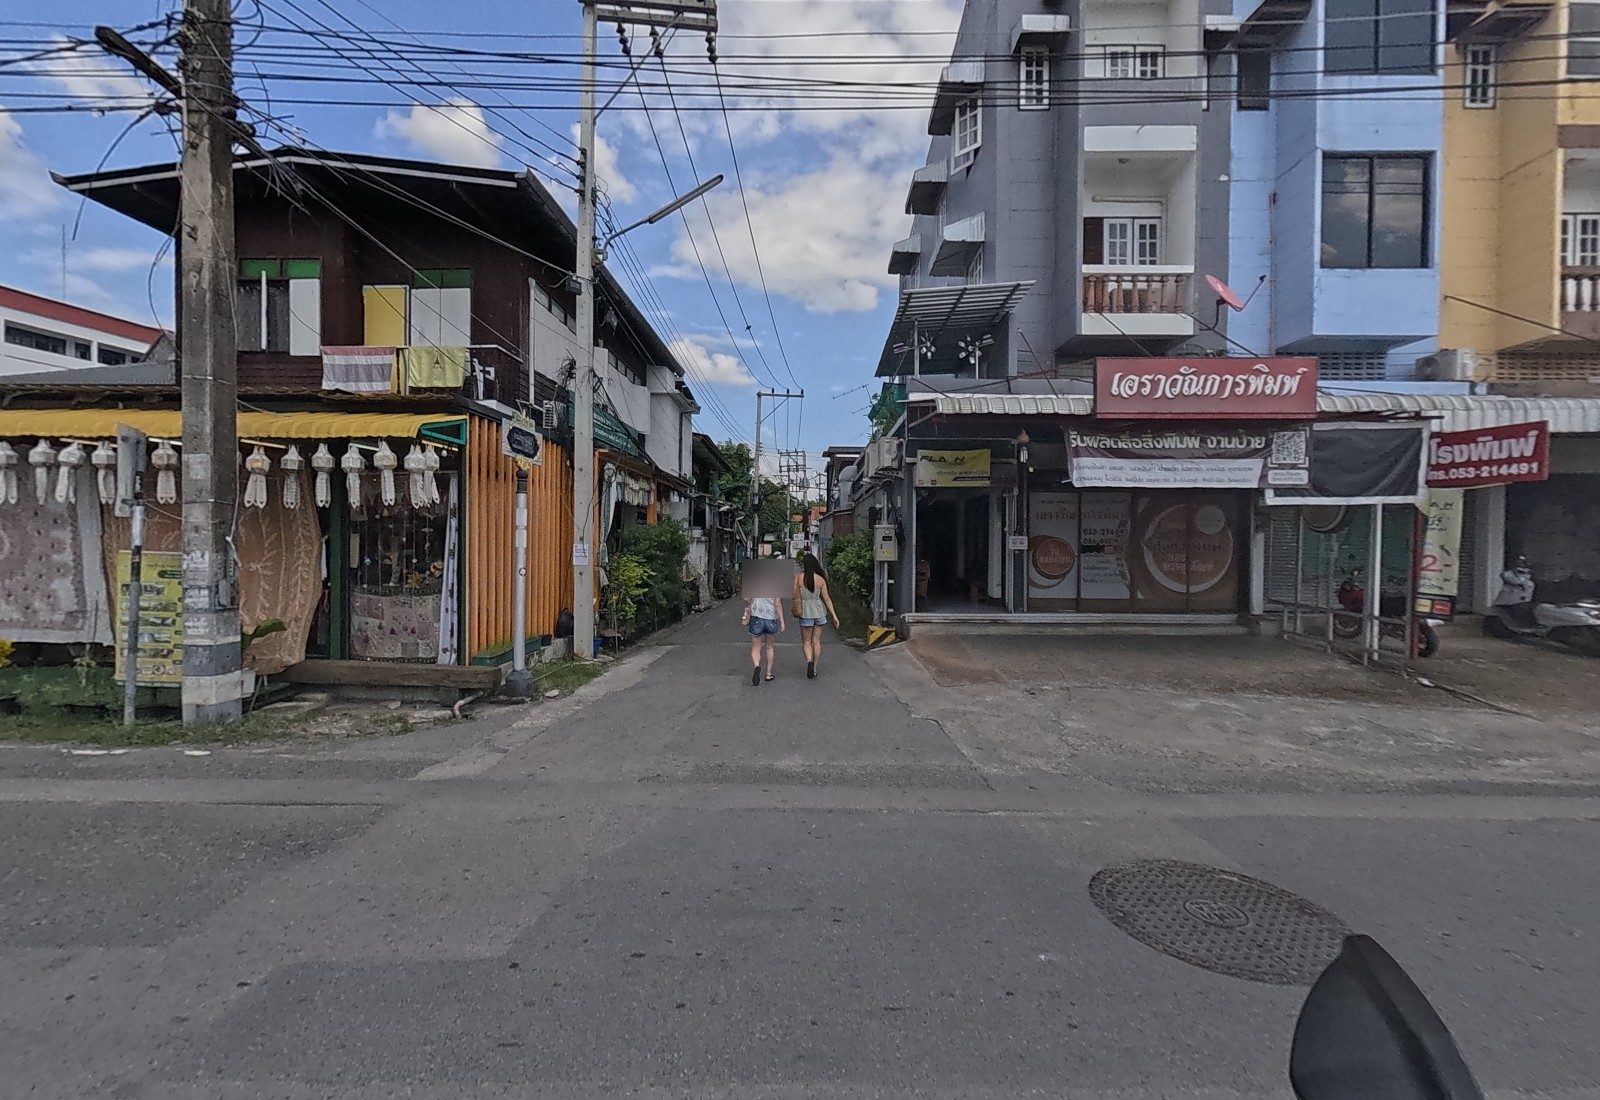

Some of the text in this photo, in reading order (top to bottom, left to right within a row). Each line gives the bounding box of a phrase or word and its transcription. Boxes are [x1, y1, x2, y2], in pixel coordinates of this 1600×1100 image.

[1110, 363, 1309, 399] เอราวัณการพิมพ์
[1207, 429, 1266, 449] งานป้าย
[1430, 429, 1540, 465] โรงพิมพ์
